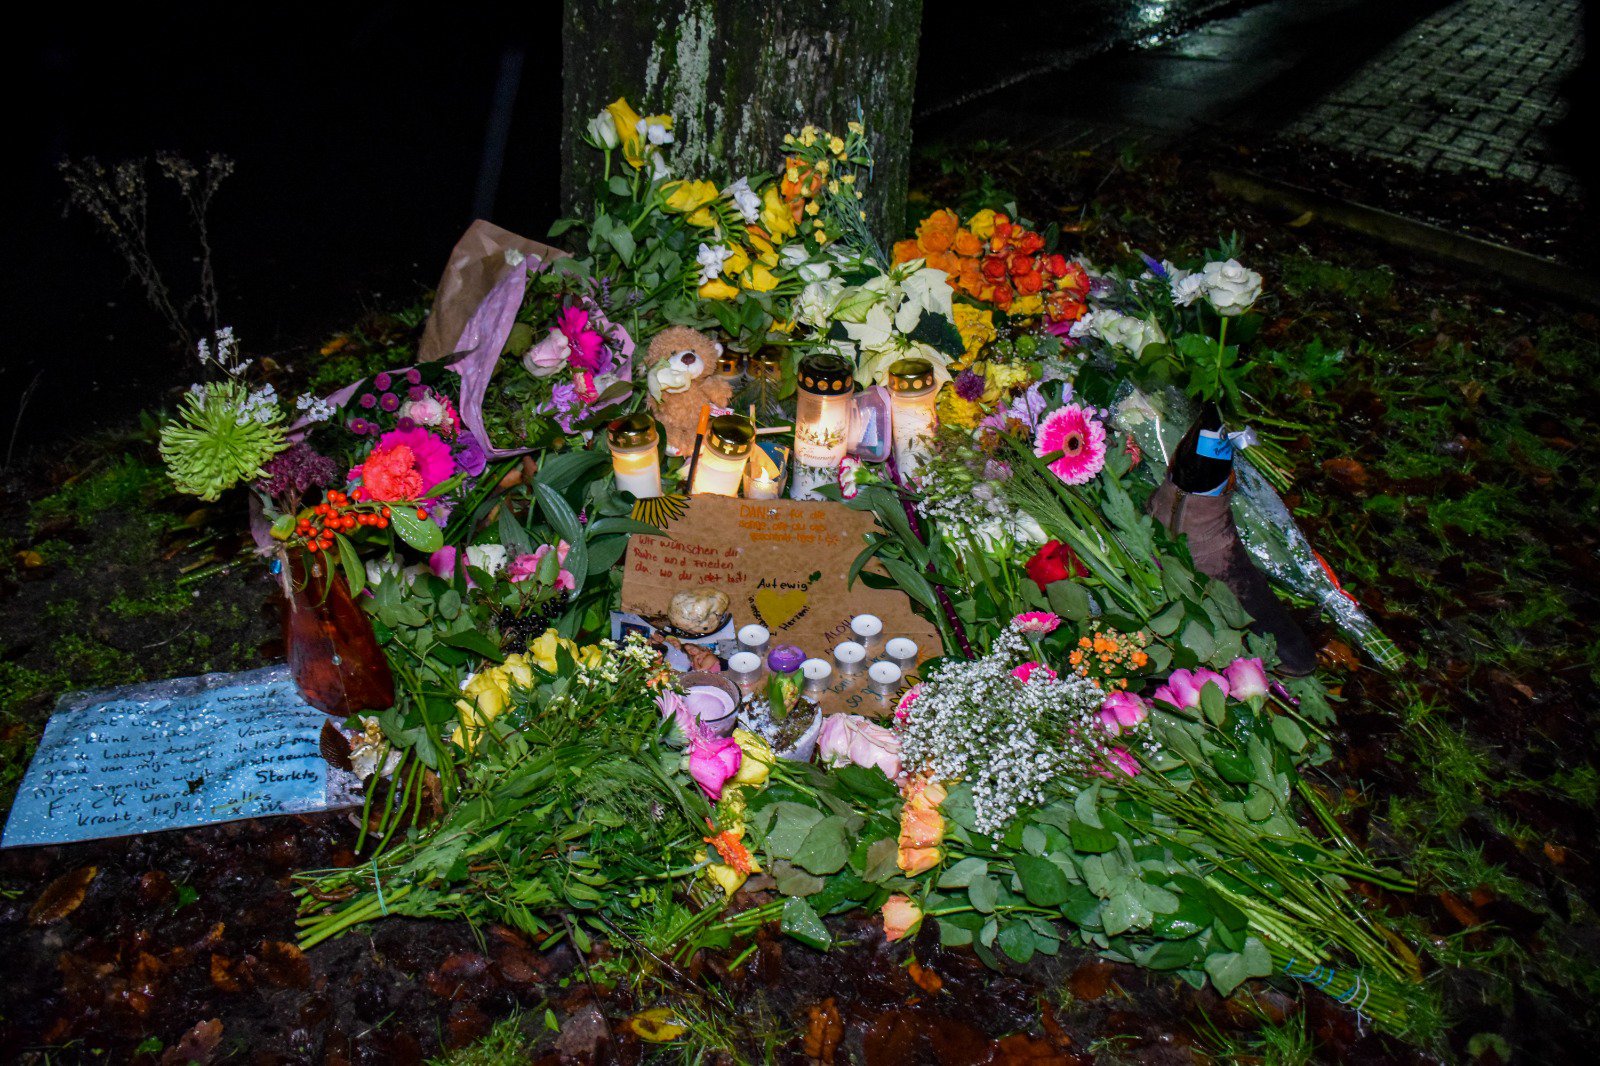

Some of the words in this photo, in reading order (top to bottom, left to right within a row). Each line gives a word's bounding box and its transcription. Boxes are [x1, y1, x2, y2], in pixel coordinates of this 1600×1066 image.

[639, 536, 654, 545] Wir
[725, 547, 739, 557] dir
[634, 547, 657, 561] Ruhe
[664, 557, 686, 567] und
[694, 560, 733, 569] Frieden
[660, 569, 673, 577] wo
[679, 570, 692, 581] du
[757, 578, 777, 589] Auf
[780, 581, 808, 592] ewig
